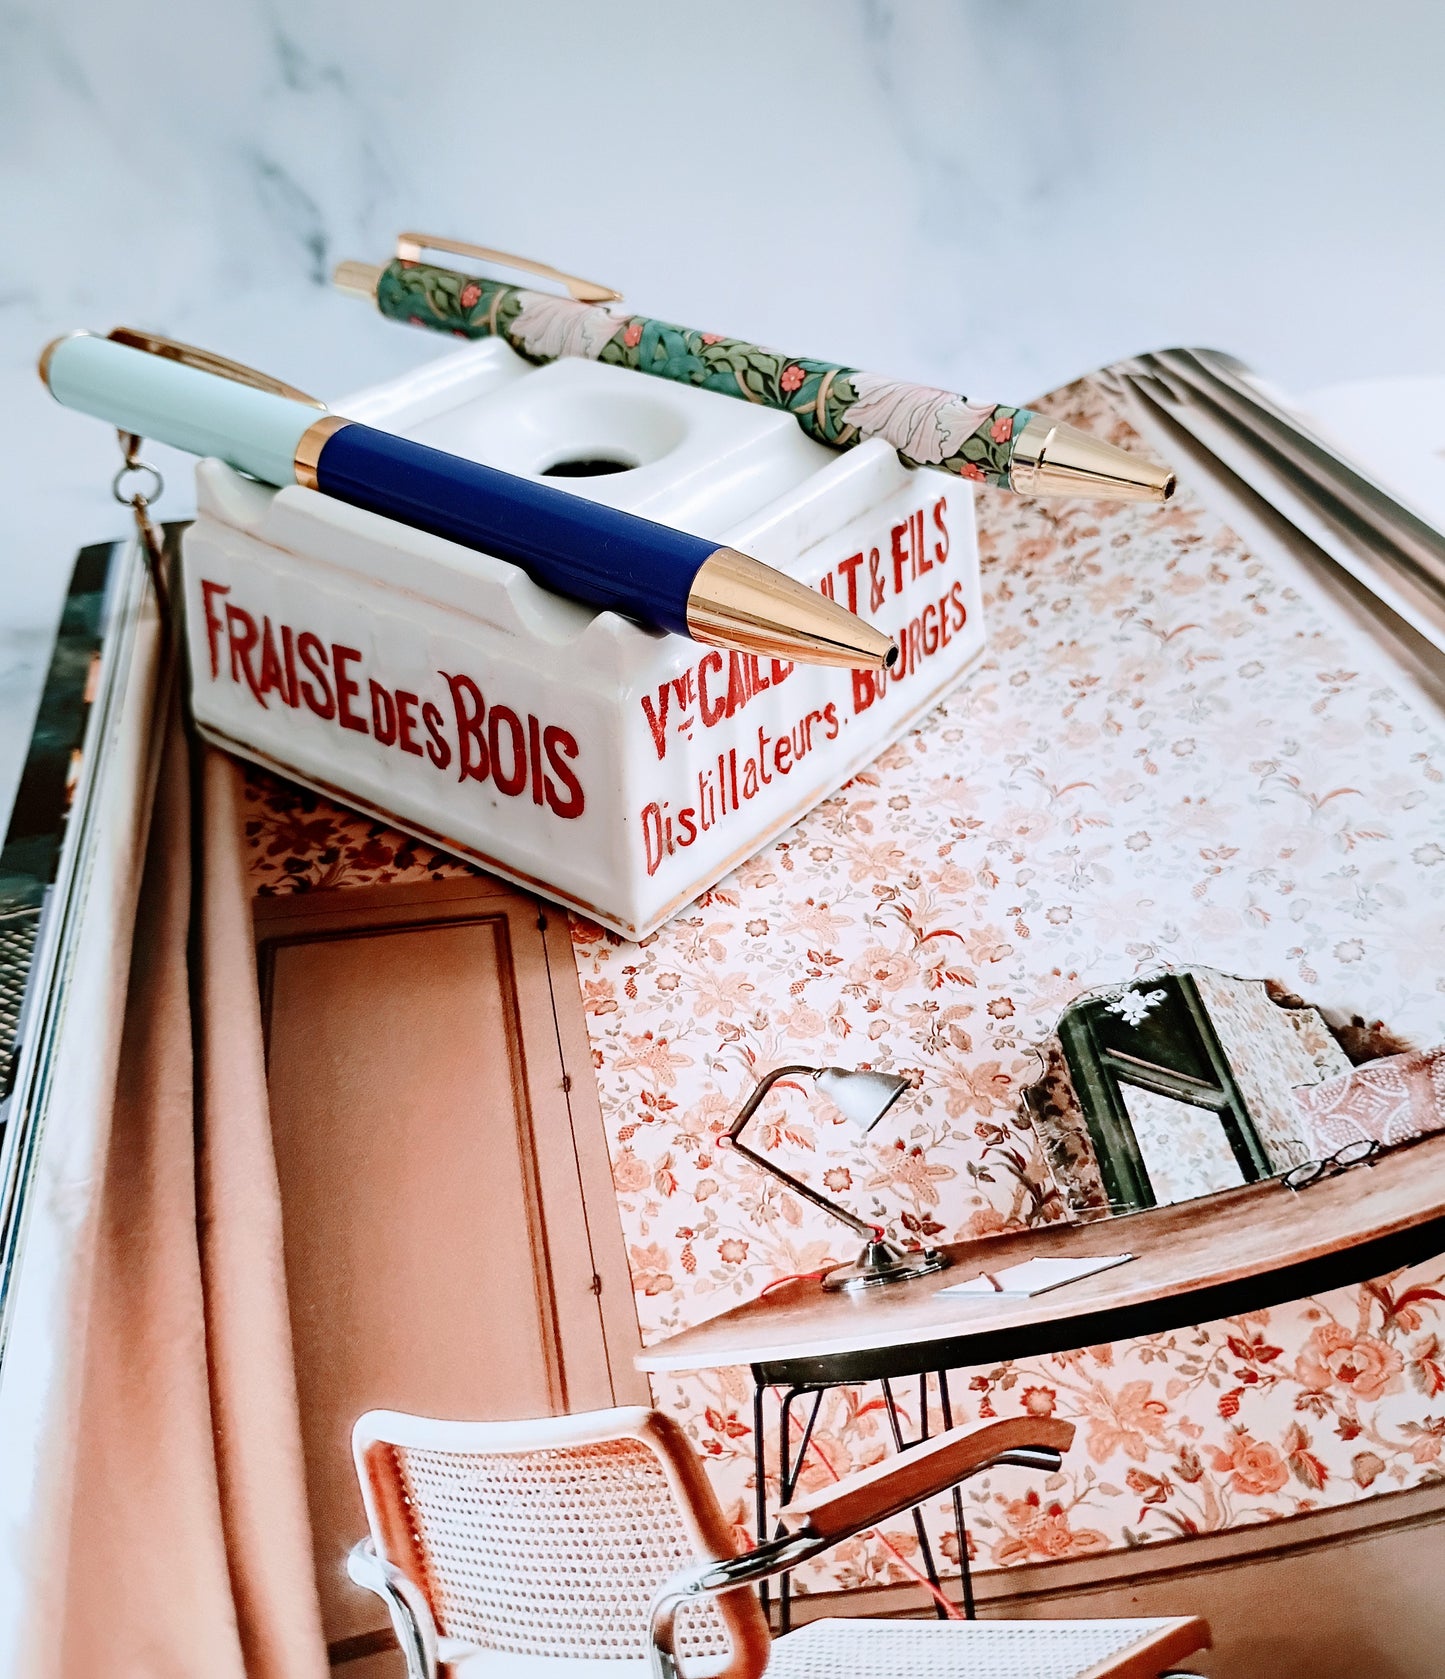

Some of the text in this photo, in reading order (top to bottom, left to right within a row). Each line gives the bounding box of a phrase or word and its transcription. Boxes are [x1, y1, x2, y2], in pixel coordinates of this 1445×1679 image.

[869, 547, 885, 613] &
[890, 497, 949, 594] FILS
[202, 579, 585, 819] FRAISE DES BOIS
